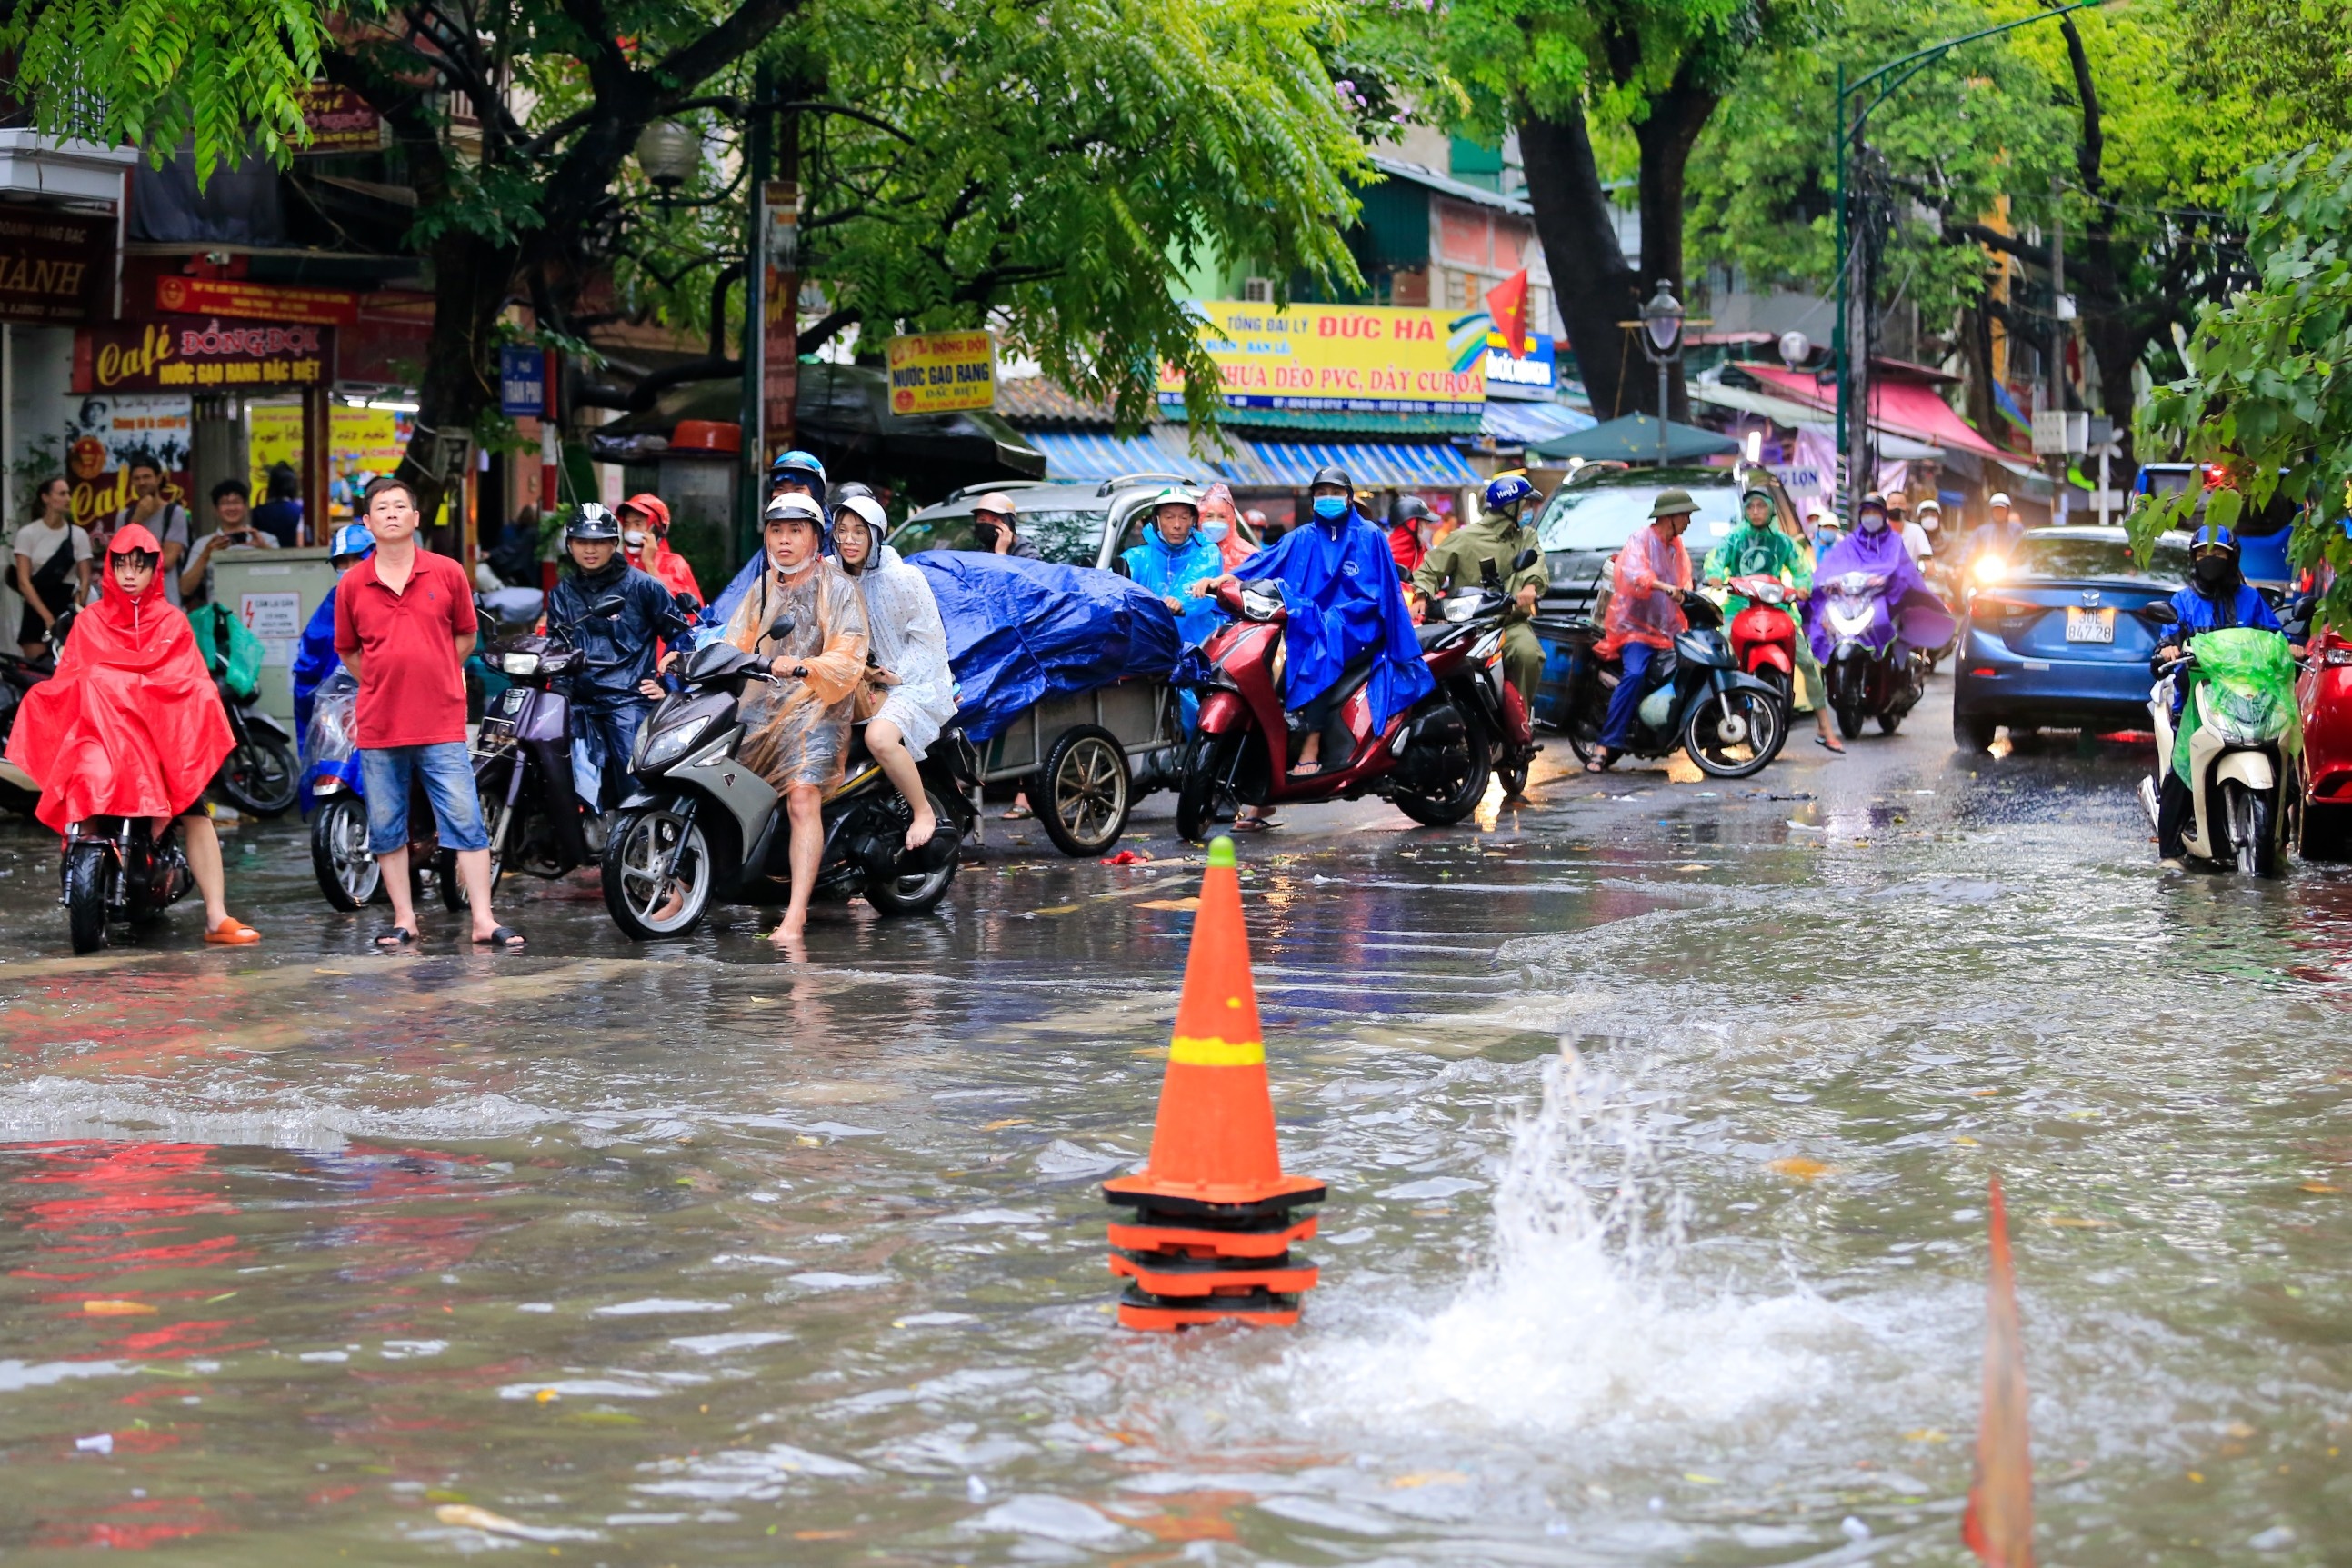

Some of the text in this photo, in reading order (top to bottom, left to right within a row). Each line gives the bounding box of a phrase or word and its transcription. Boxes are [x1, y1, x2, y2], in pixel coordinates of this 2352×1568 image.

[181, 318, 266, 357] ĐỒNG
[1227, 313, 1261, 331] TỔNG
[1266, 316, 1289, 336] ĐẠI
[1317, 312, 1436, 341] ĐỨC HÀ
[96, 323, 175, 386] Café
[159, 360, 195, 385] NƯỚC
[196, 364, 224, 387] GẠO
[225, 362, 261, 382] RANG
[263, 357, 290, 385] ĐẶC
[892, 365, 926, 388] NƯỚC
[956, 363, 989, 383] RANG
[1320, 367, 1364, 395] PVC,
[1496, 482, 1519, 499] HeyU
